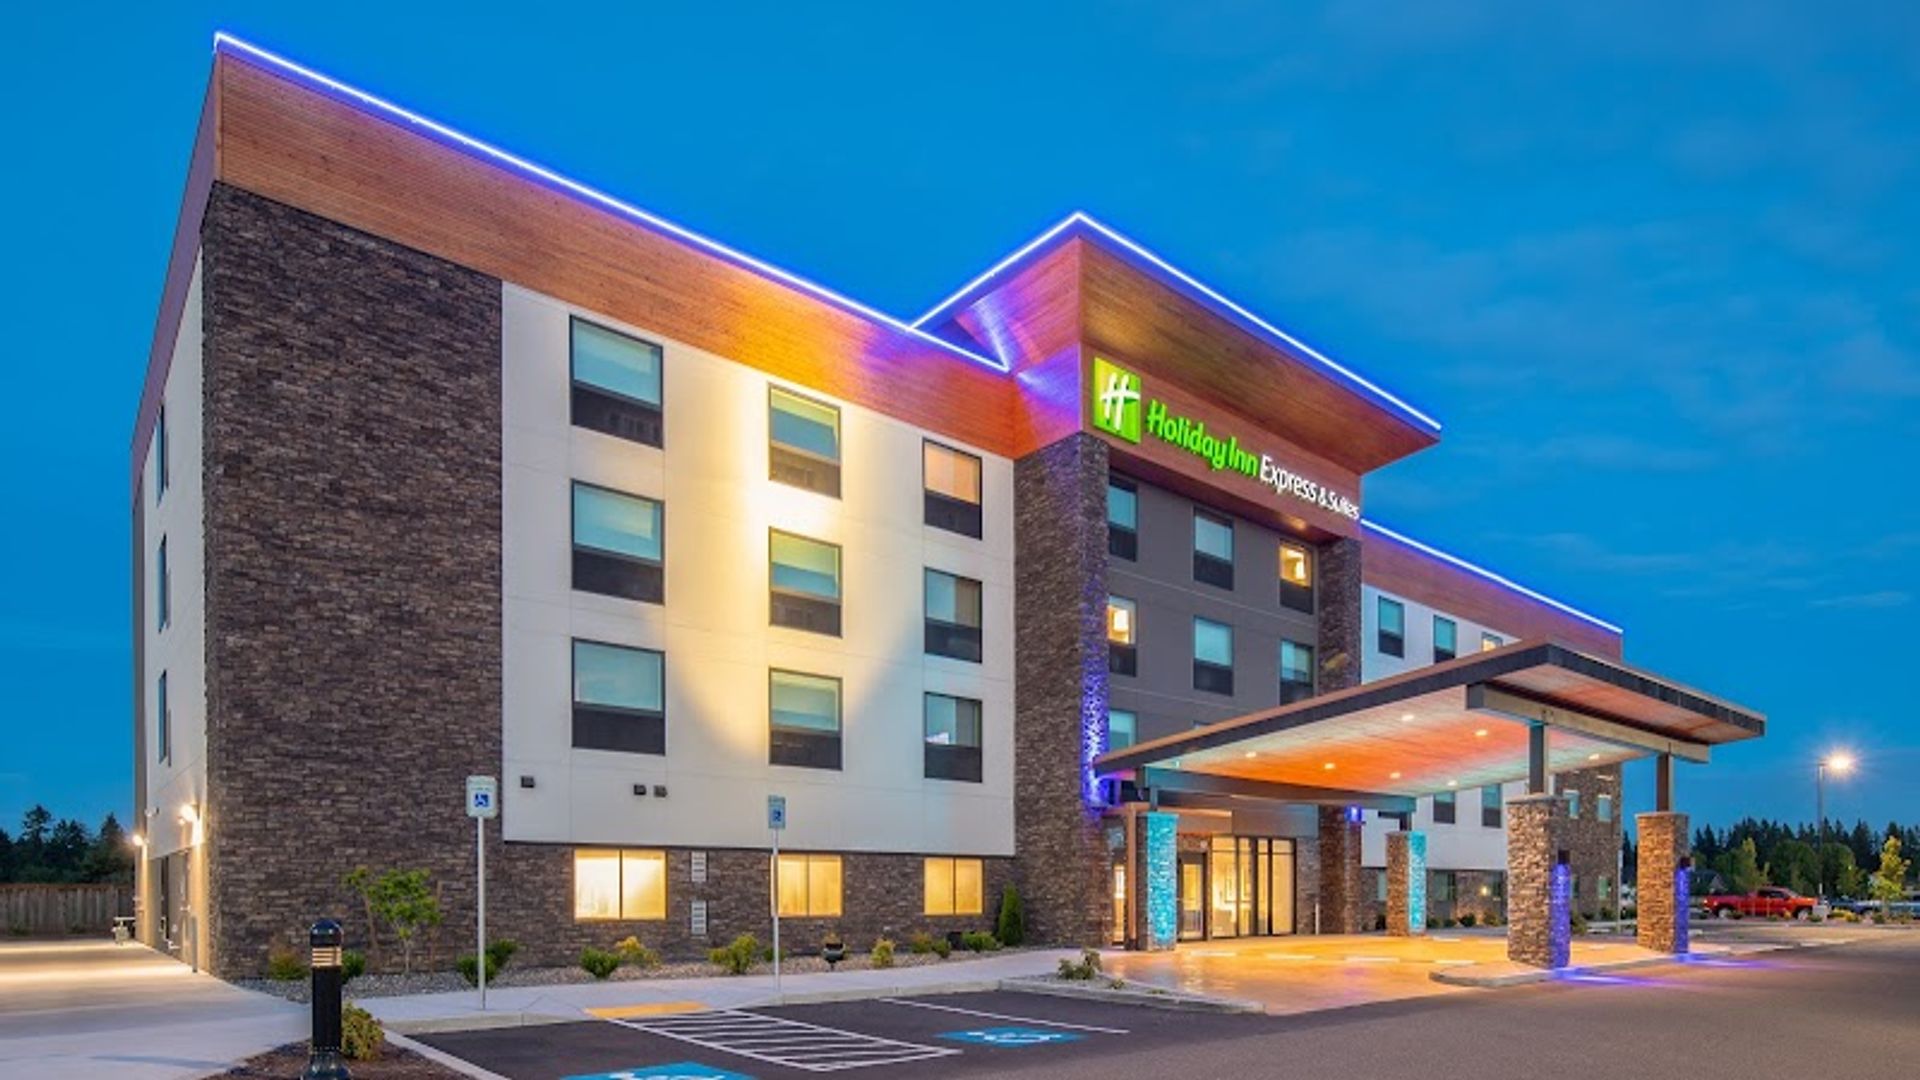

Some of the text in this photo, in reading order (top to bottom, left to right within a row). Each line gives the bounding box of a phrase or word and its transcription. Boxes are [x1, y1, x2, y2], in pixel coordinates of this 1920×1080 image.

[1146, 398, 1360, 520] Holiday Inn Express & Suites
